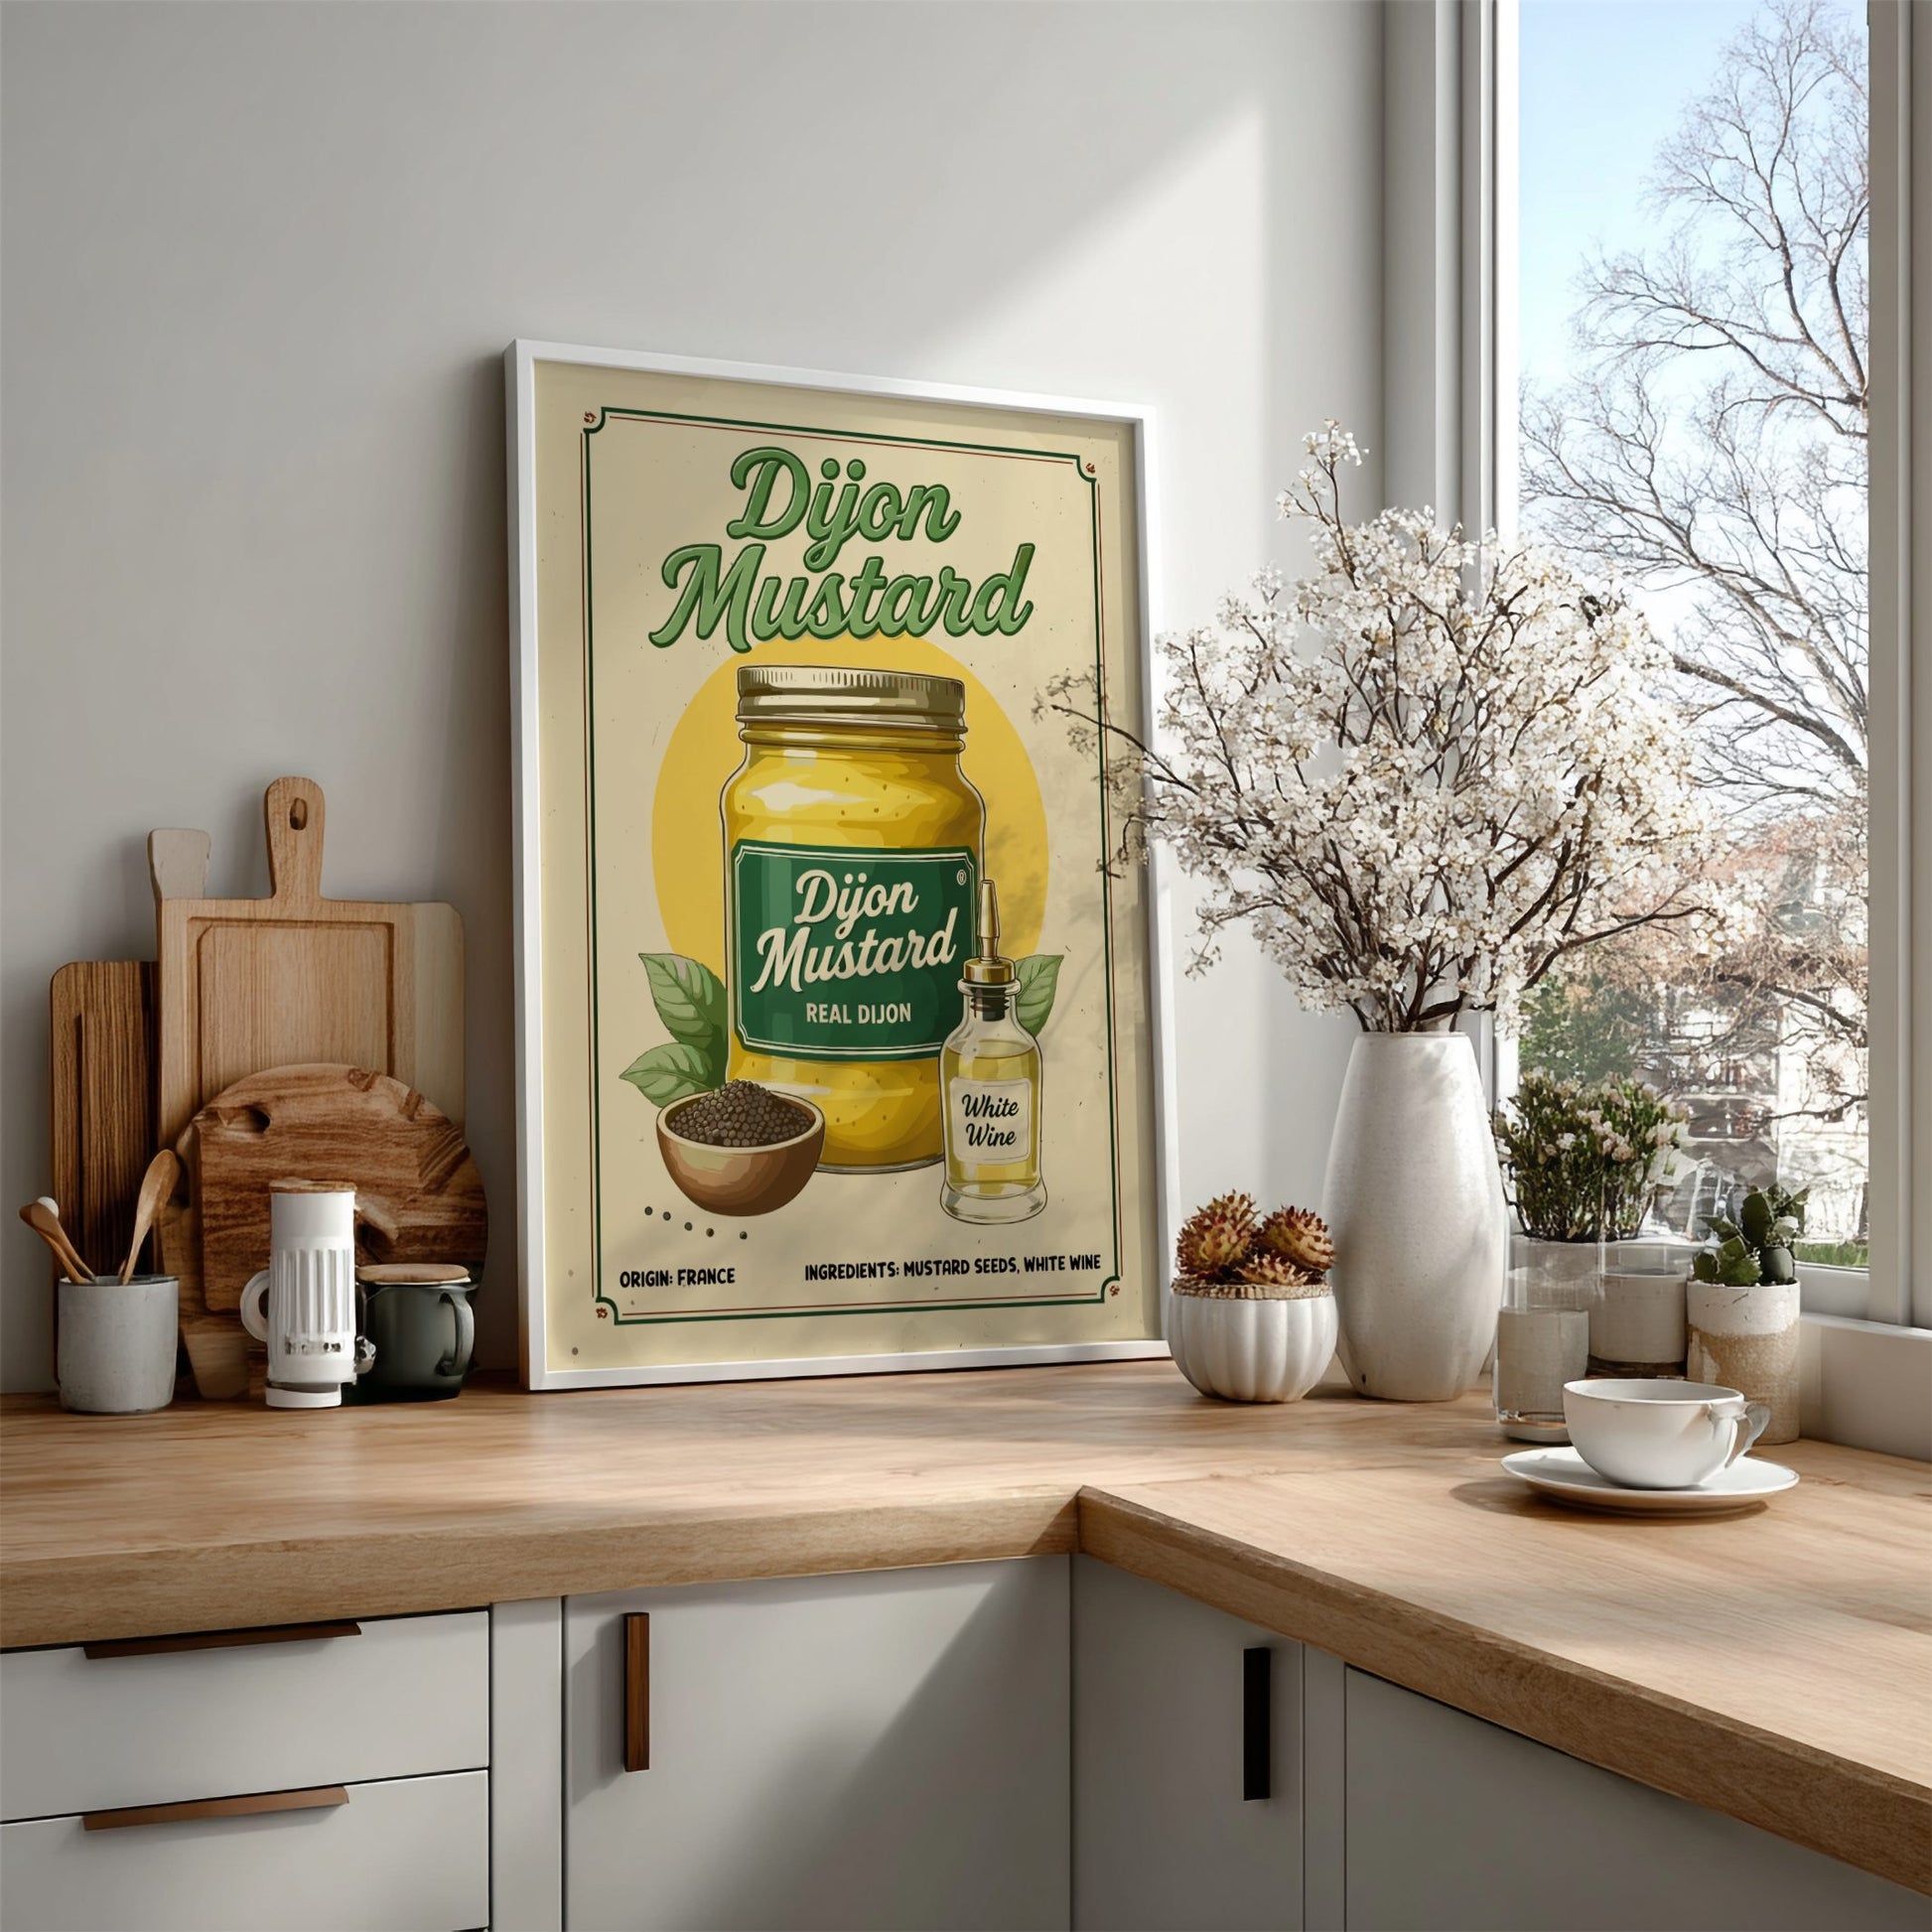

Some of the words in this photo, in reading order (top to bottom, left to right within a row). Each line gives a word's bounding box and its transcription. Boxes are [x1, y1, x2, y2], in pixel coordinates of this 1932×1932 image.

[726, 447, 961, 572] Dijon
[648, 542, 1035, 653] Mustard
[794, 870, 918, 940] Dijon
[750, 906, 958, 994] Mustard
[806, 1003, 852, 1025] REAL
[858, 1003, 911, 1025] DIJON
[961, 1093, 1020, 1119] White
[966, 1123, 1017, 1147] Wine
[620, 1270, 673, 1288] ORIGIN:
[677, 1268, 736, 1286] FRANCE
[804, 1261, 899, 1281] INGREDIENTS:
[903, 1259, 970, 1277] MUSTARD
[974, 1257, 1021, 1274] SEEDS,
[1024, 1255, 1066, 1273] WHITE
[1069, 1254, 1101, 1271] WINE
